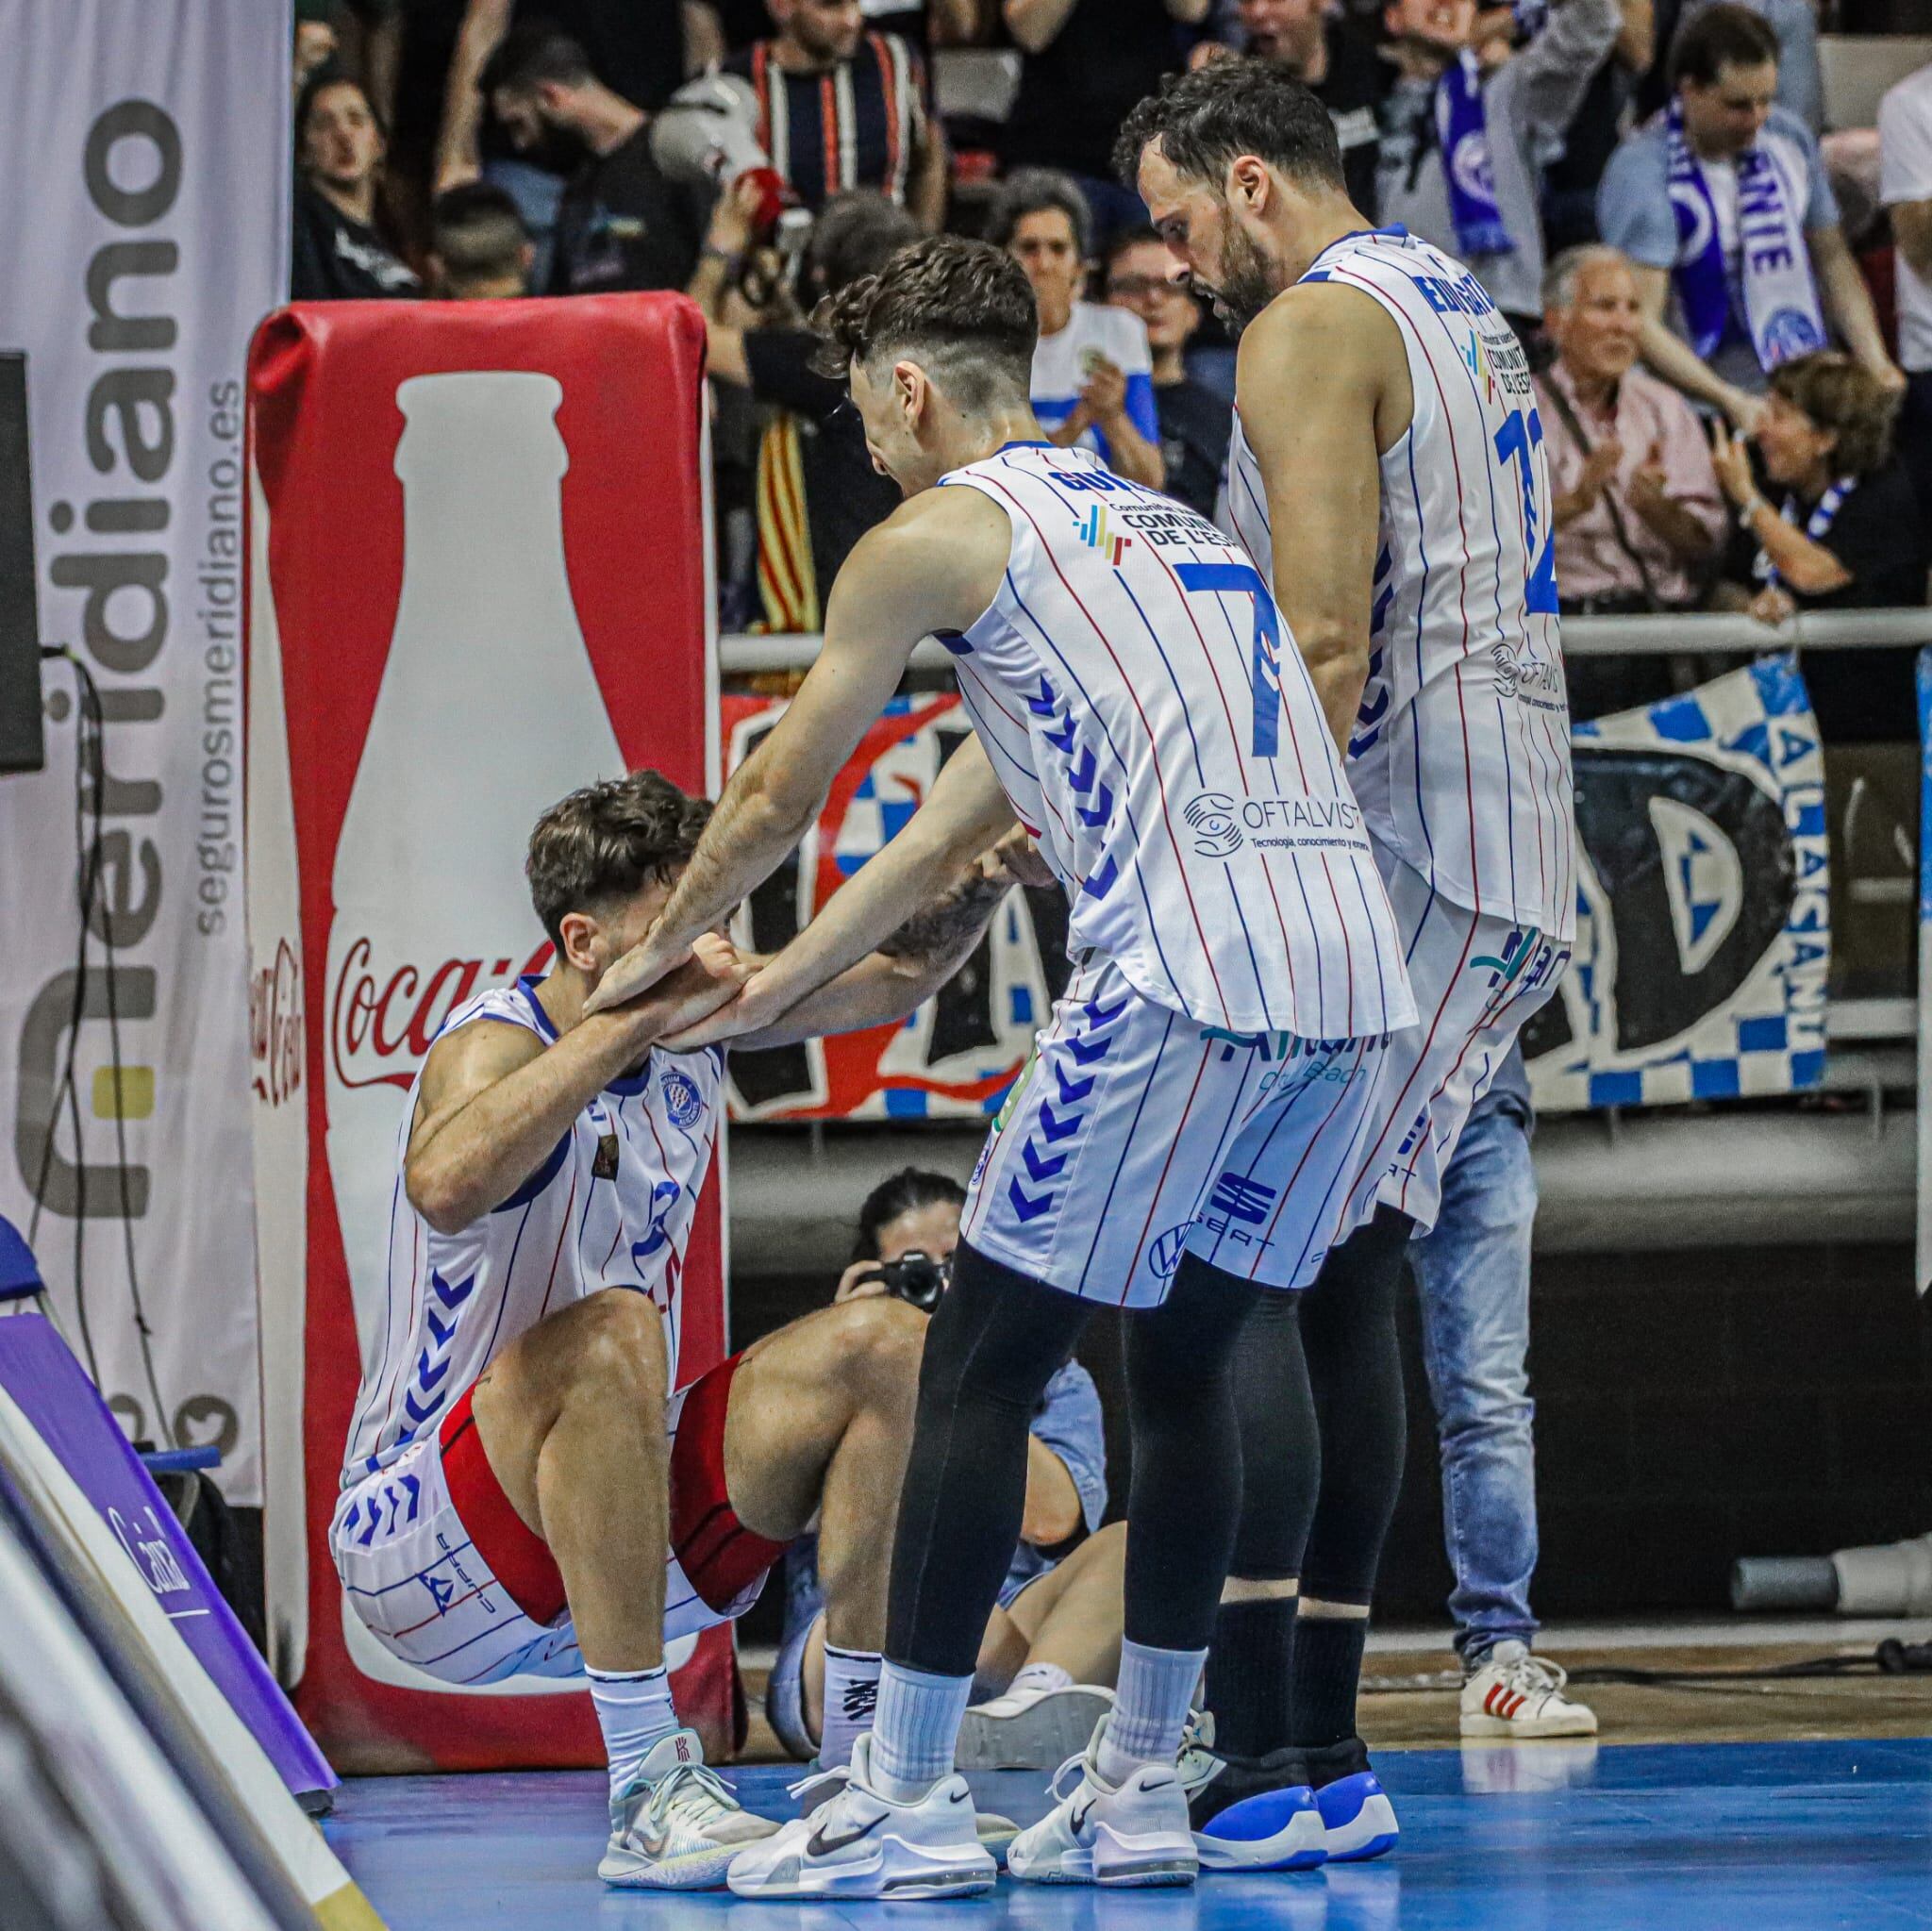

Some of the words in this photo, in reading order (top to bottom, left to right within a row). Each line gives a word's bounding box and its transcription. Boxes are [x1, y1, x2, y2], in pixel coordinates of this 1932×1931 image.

[15, 98, 184, 1221] meridiano
[196, 379, 242, 937] segurosmeridiano.es
[1146, 529, 1186, 546] DE
[1173, 563, 1280, 757] 7
